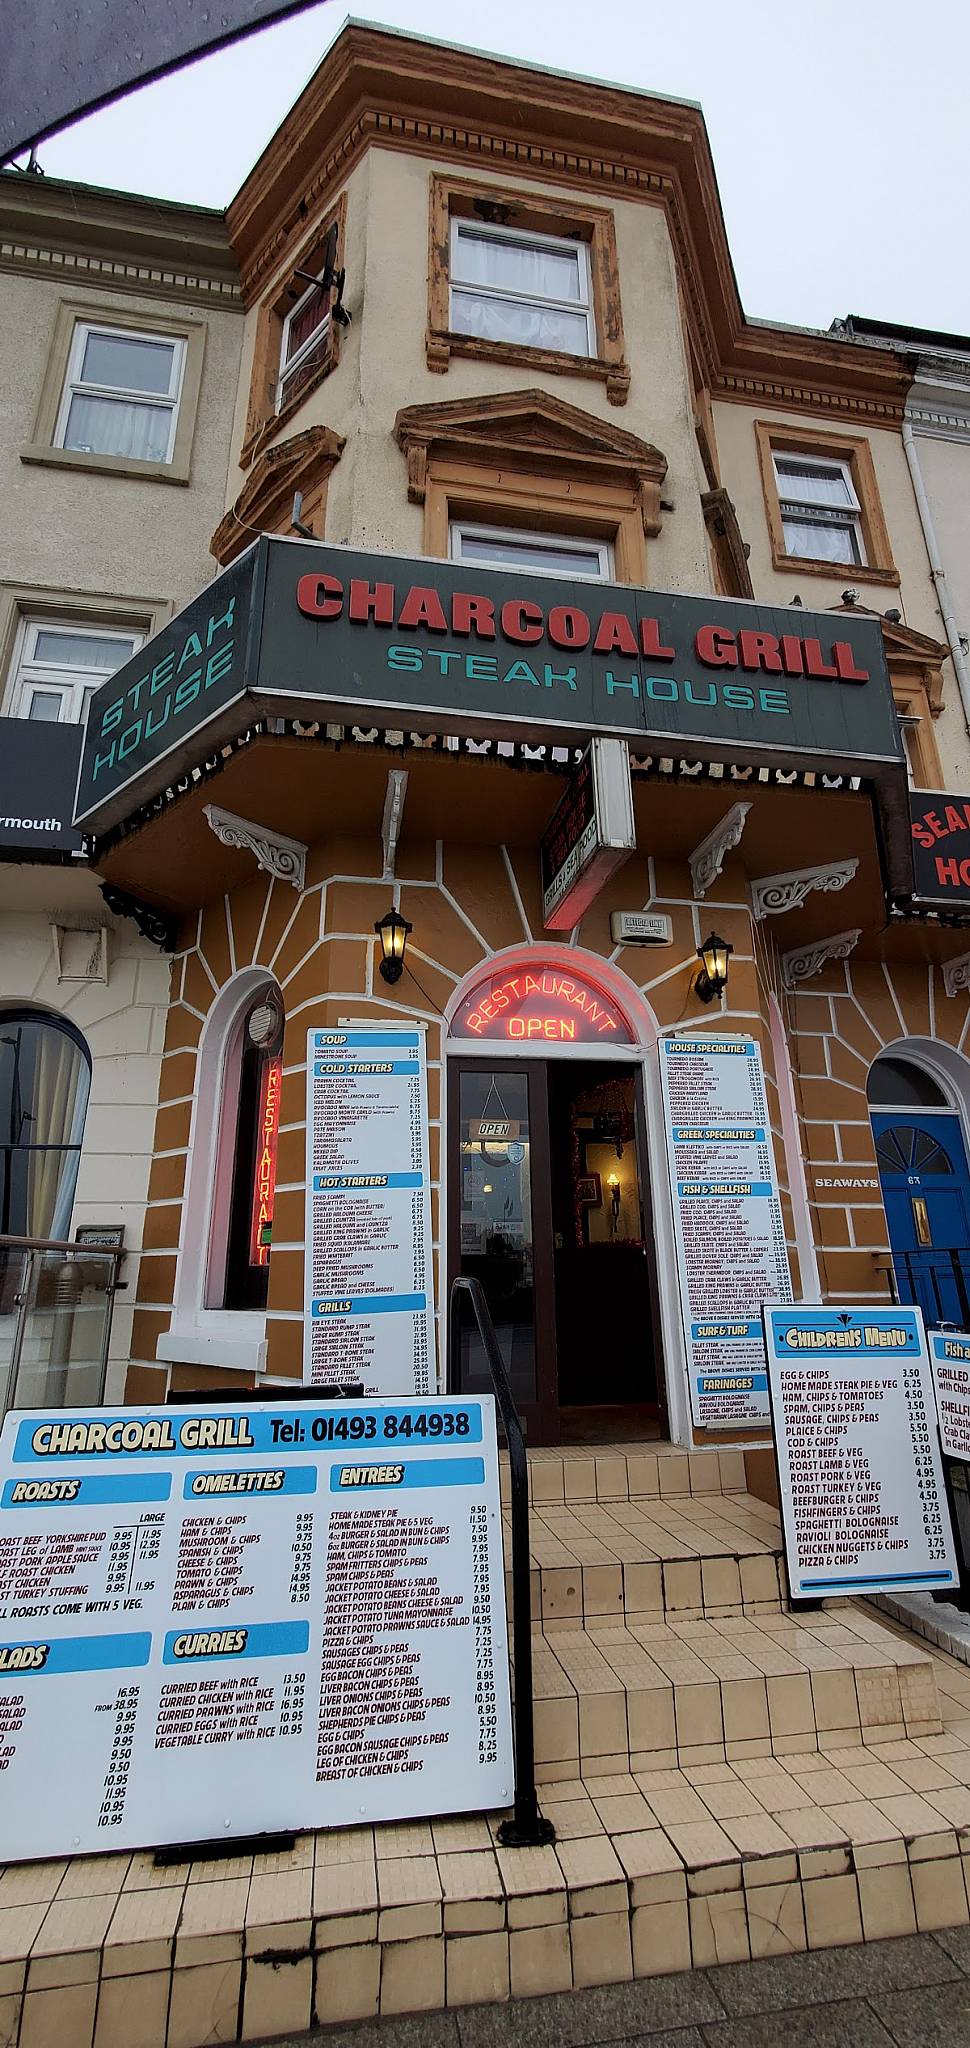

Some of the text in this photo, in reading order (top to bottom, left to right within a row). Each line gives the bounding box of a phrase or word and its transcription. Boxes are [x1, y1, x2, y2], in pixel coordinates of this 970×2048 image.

[296, 573, 870, 684] CHARCOAL GRILL
[101, 596, 236, 737] STEAK
[386, 644, 790, 714] STEAK HOUSE
[93, 639, 234, 781] HOUSE
[466, 975, 617, 1034] RESTAURANT
[509, 1018, 575, 1038] OPEN
[320, 1035, 347, 1045] SOUP
[669, 1043, 747, 1054] HOUSE SPECIALITIES
[320, 1063, 392, 1073] COLD STARTERS
[479, 1123, 509, 1135] OPEN
[677, 1130, 756, 1140] GREEK SPECIALITIES
[319, 1175, 388, 1188] HOT STARTERS
[815, 1178, 878, 1188] SEAWAYS
[682, 1185, 751, 1195] FISH & SHELLFISH
[318, 1301, 352, 1314] GRILLS
[785, 1326, 907, 1348] CHILDRENS MENU
[944, 1341, 964, 1358] Fish
[780, 1369, 920, 1380] EGG & CHIPS 3.50
[937, 1368, 969, 1382] GRILLED
[703, 1378, 753, 1391] FARINAGES
[781, 1380, 921, 1391] HOME MADE STEAK PIE & VEG 6.25
[938, 1381, 953, 1391] with
[784, 1401, 924, 1413] SPAM, CHIPS & PEAS 3.50
[32, 1412, 470, 1456] CHARCOAL GRILL Tel: 01493 844938
[786, 1423, 927, 1436] PLAICE & CHIPS 5.50
[944, 1425, 958, 1436] Crab
[945, 1437, 951, 1447] in
[192, 1470, 286, 1495] OMELETTES
[339, 1464, 405, 1487] ENTREES
[12, 1480, 82, 1502] ROASTS
[139, 1513, 166, 1522] LARGE
[182, 1513, 314, 1527] CHICKEN & CHIPS 9.95
[330, 1511, 352, 1520] STEAK
[359, 1510, 386, 1518] KIDNEY
[387, 1509, 398, 1517] PIE
[470, 1506, 487, 1514] 9.50
[795, 1514, 941, 1530] SPAGHETTI BOLOGNAISE 6.25
[178, 1543, 312, 1558] SPANISH & CHIPS 10.50
[798, 1538, 944, 1554] CHICKEN NUGGETS & CHIPS 3.75
[799, 1550, 946, 1567] PIZZA & CHIPS 3.75
[10, 1606, 49, 1618] ROASTS
[53, 1602, 82, 1615] COME
[85, 1601, 111, 1612] WITH
[112, 1600, 120, 1610] 5
[123, 1599, 143, 1610] VEG.
[173, 1629, 248, 1658] CURRIES
[0, 1645, 50, 1672] LADS
[161, 1673, 305, 1695] CURRIED BEEF with RICE 13.50
[155, 1724, 302, 1749] VEGETABLE CURRY with RICE 10.95
[316, 1752, 497, 1782] BREAST OF CHICKEN & CHIPS 9.95
